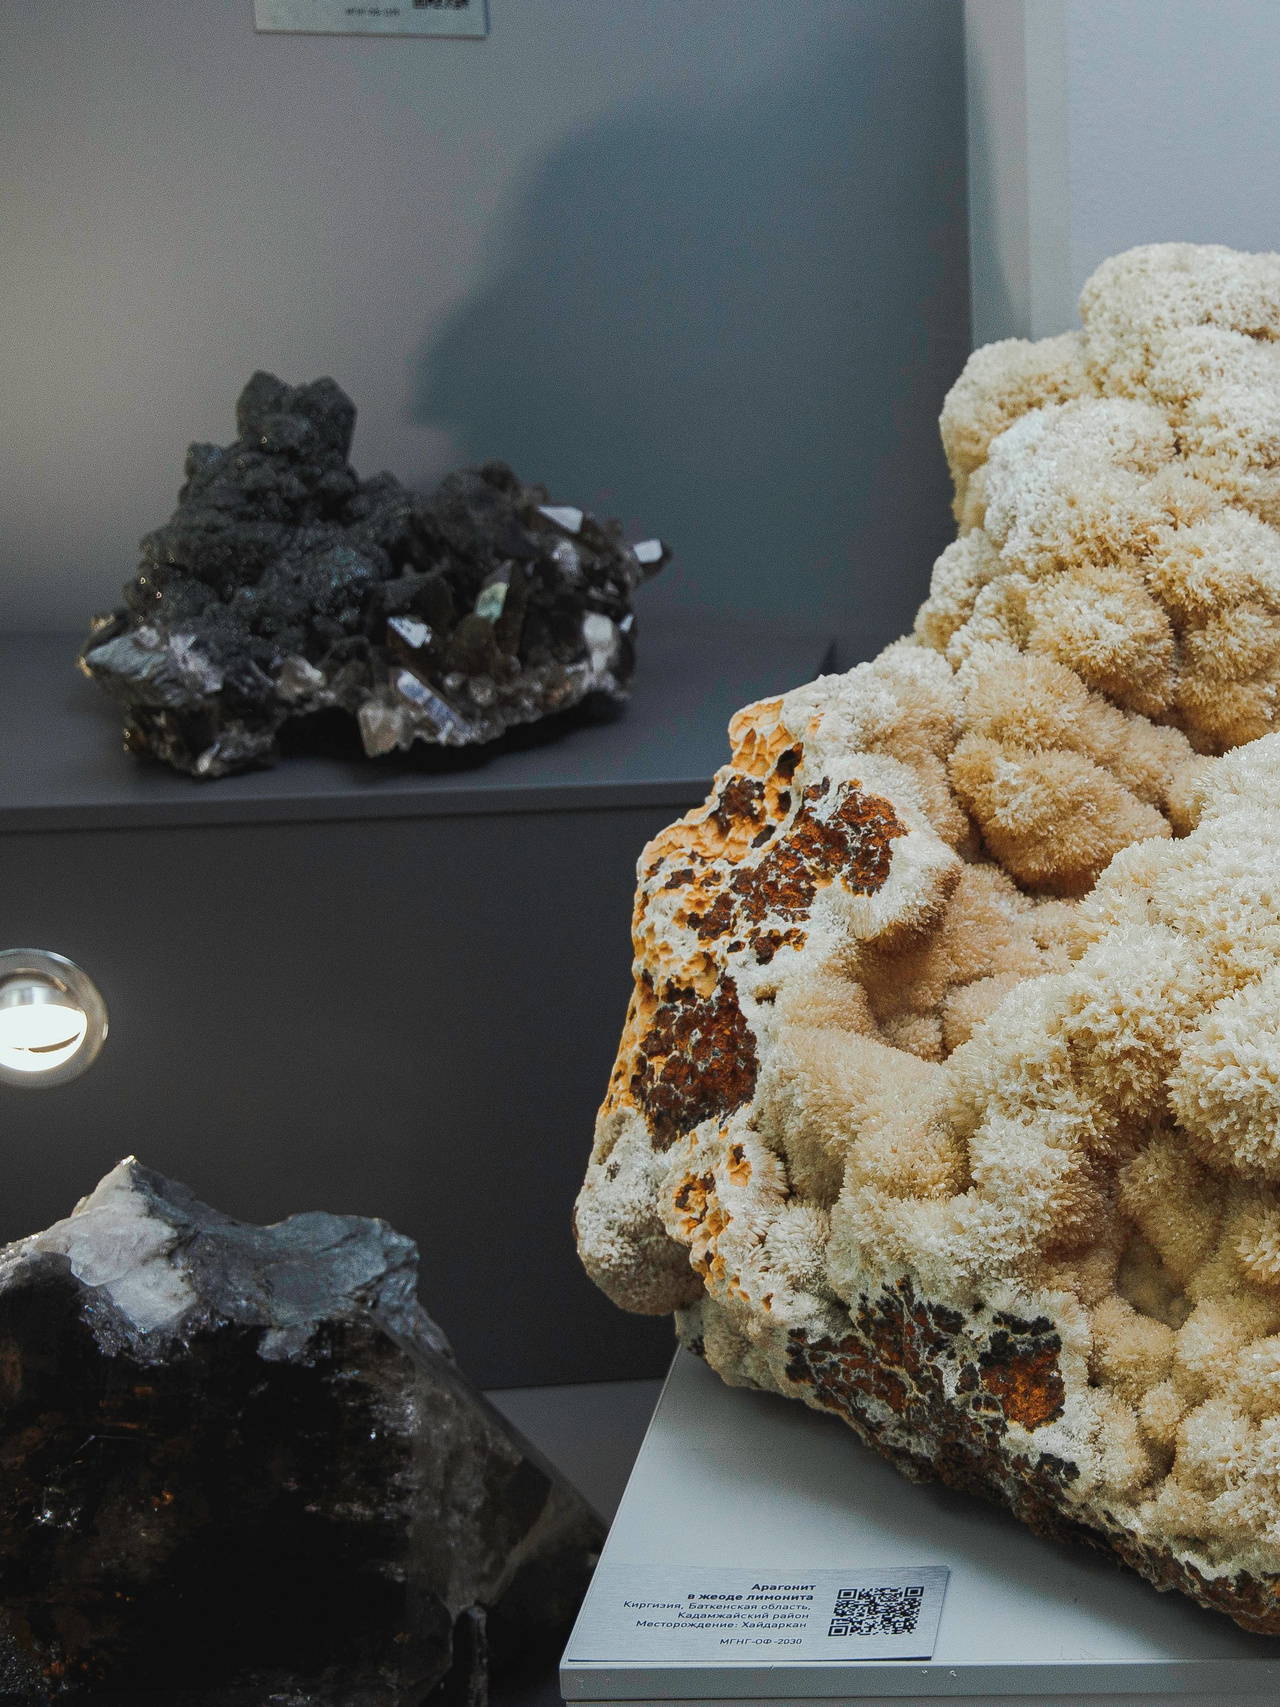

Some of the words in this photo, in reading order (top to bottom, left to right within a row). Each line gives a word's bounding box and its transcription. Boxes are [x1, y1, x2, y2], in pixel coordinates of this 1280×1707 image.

[751, 1583, 816, 1592] Арагонит
[698, 1593, 743, 1602] жеоде
[746, 1593, 814, 1601] лимонита
[623, 1600, 684, 1610] Киргизия,
[688, 1602, 758, 1610] Баткенская
[761, 1603, 811, 1611] область,
[677, 1611, 769, 1620] Кадамжайский
[772, 1612, 809, 1620] район
[635, 1620, 738, 1629] Месторождение:
[741, 1621, 807, 1630] Хайдаркан
